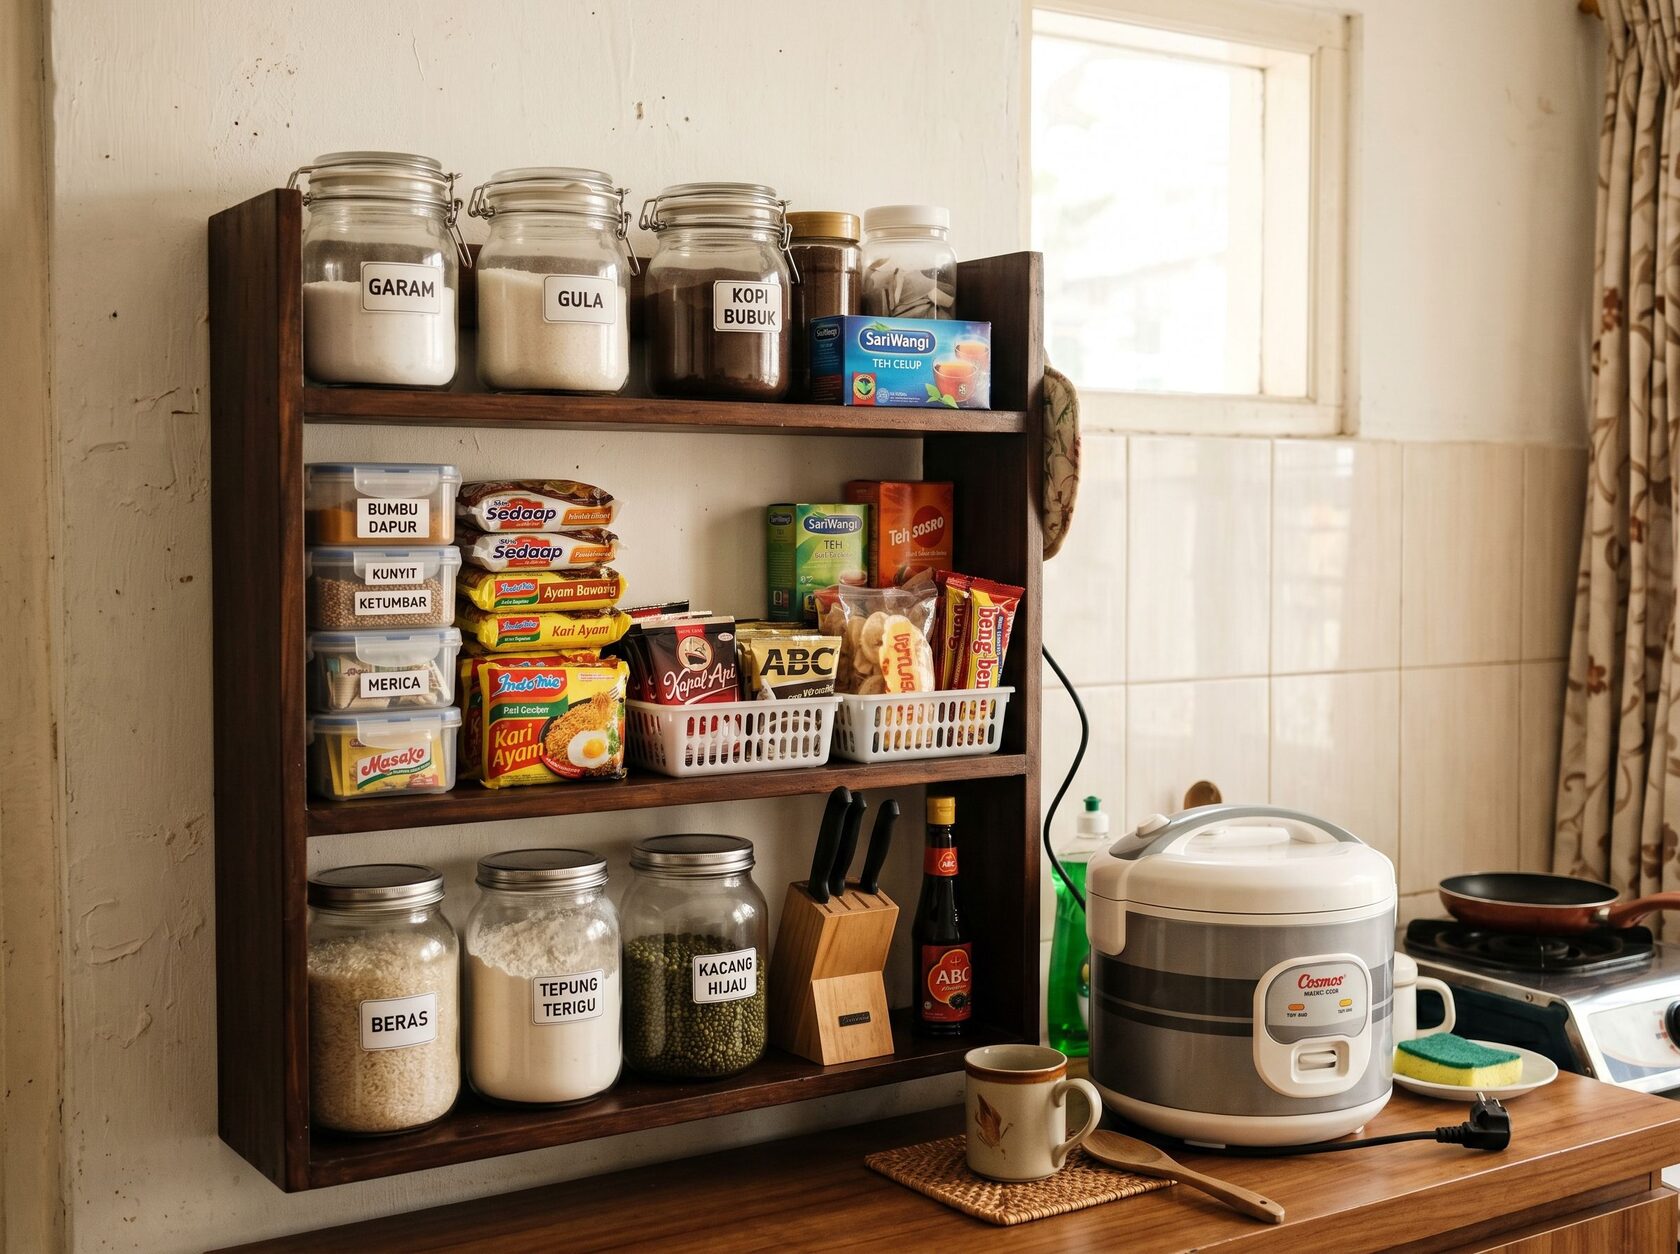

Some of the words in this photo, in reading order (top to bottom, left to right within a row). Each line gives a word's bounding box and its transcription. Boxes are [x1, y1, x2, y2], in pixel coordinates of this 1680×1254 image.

[368, 278, 435, 298] GARAM
[732, 287, 768, 304] KOPI
[557, 290, 604, 308] GULA
[723, 309, 776, 326] BUBUK
[865, 331, 930, 351] SariWangi
[872, 358, 892, 369] TEH
[893, 359, 922, 370] CELUP
[368, 503, 418, 515] BUMBU
[486, 505, 557, 523] Sedaap
[369, 521, 417, 533] DAPUR
[808, 518, 858, 532] SariWangi
[889, 529, 910, 546] Teh
[912, 517, 944, 538] SOSRO
[493, 544, 563, 561] Sedaap
[823, 540, 843, 549] TEH
[372, 568, 418, 579] KUNYIT
[544, 585, 574, 599] Ayam
[359, 596, 427, 609] KETUMBAR
[552, 625, 575, 637] Kari
[578, 625, 610, 638] Ayam
[972, 605, 1000, 689] beng-ben
[760, 647, 835, 676] ABC
[368, 676, 421, 691] MERICA
[663, 668, 708, 701] Kapal
[709, 662, 736, 688] Api
[495, 722, 533, 748] Kari
[361, 747, 425, 776] Masako
[492, 742, 544, 771] Ayam
[699, 957, 753, 977] KACANG
[936, 967, 969, 985] ABC
[539, 978, 598, 998] TEPUNG
[708, 977, 748, 996] HIJAU
[1297, 974, 1344, 989] Cosmos
[543, 998, 596, 1018] TERIGU
[371, 1010, 429, 1033] BERAS
